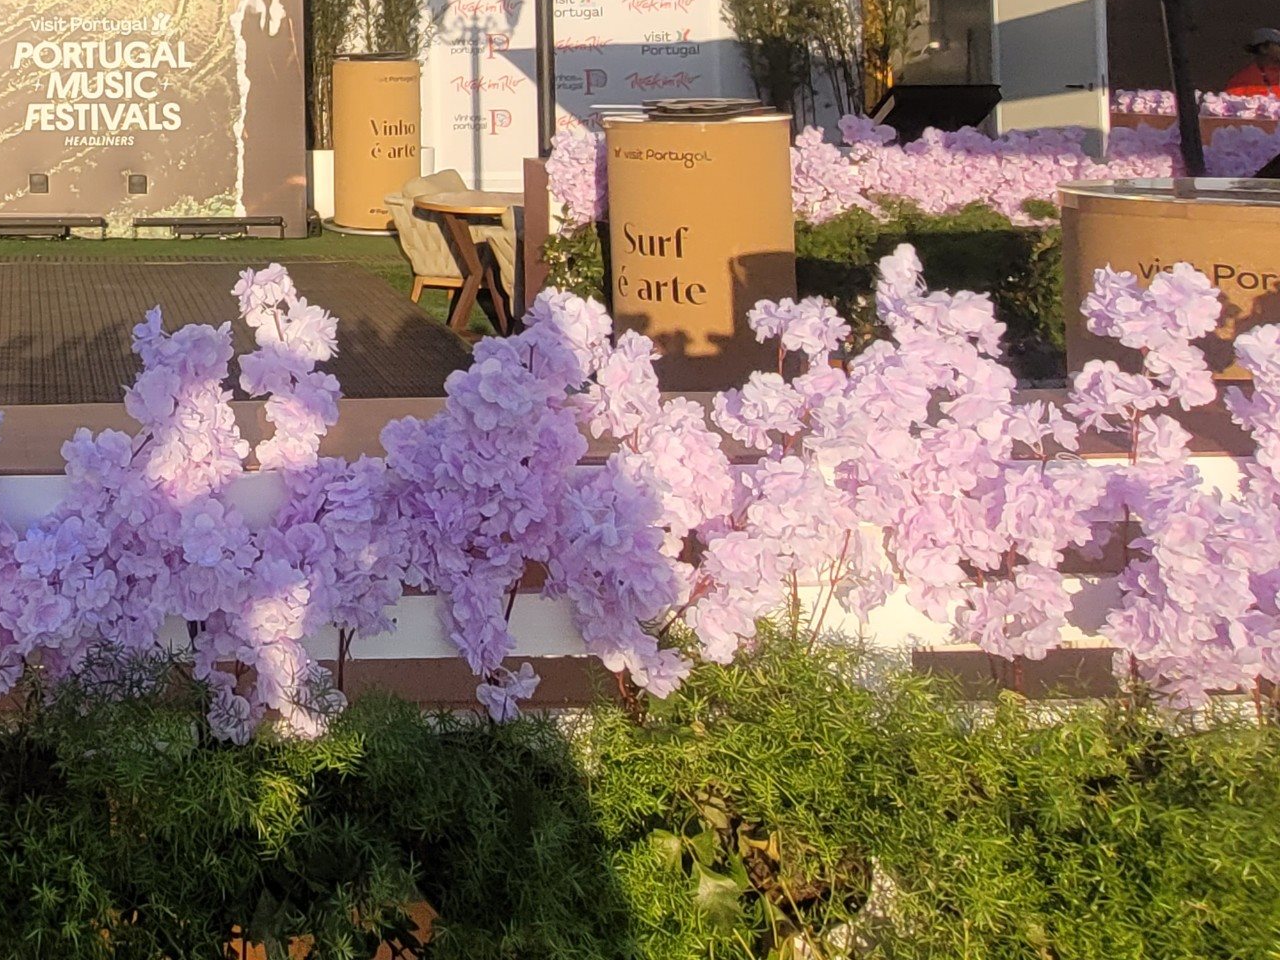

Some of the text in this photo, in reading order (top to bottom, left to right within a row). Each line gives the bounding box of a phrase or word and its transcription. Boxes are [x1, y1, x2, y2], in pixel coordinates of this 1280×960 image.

[554, 6, 604, 20] ortugal
[30, 15, 148, 36] visit Portugal
[644, 31, 671, 43] visit
[12, 40, 194, 70] PORTUGAL
[641, 43, 701, 58] Portugal
[46, 70, 159, 100] MUSIC
[24, 102, 182, 132] FESTIVALS
[370, 119, 416, 136] Vinho
[64, 136, 135, 147] HEADLINERS
[370, 142, 416, 159] é arte
[624, 148, 713, 169] visit Portugal
[623, 222, 690, 259] Surf
[617, 265, 708, 306] é arte
